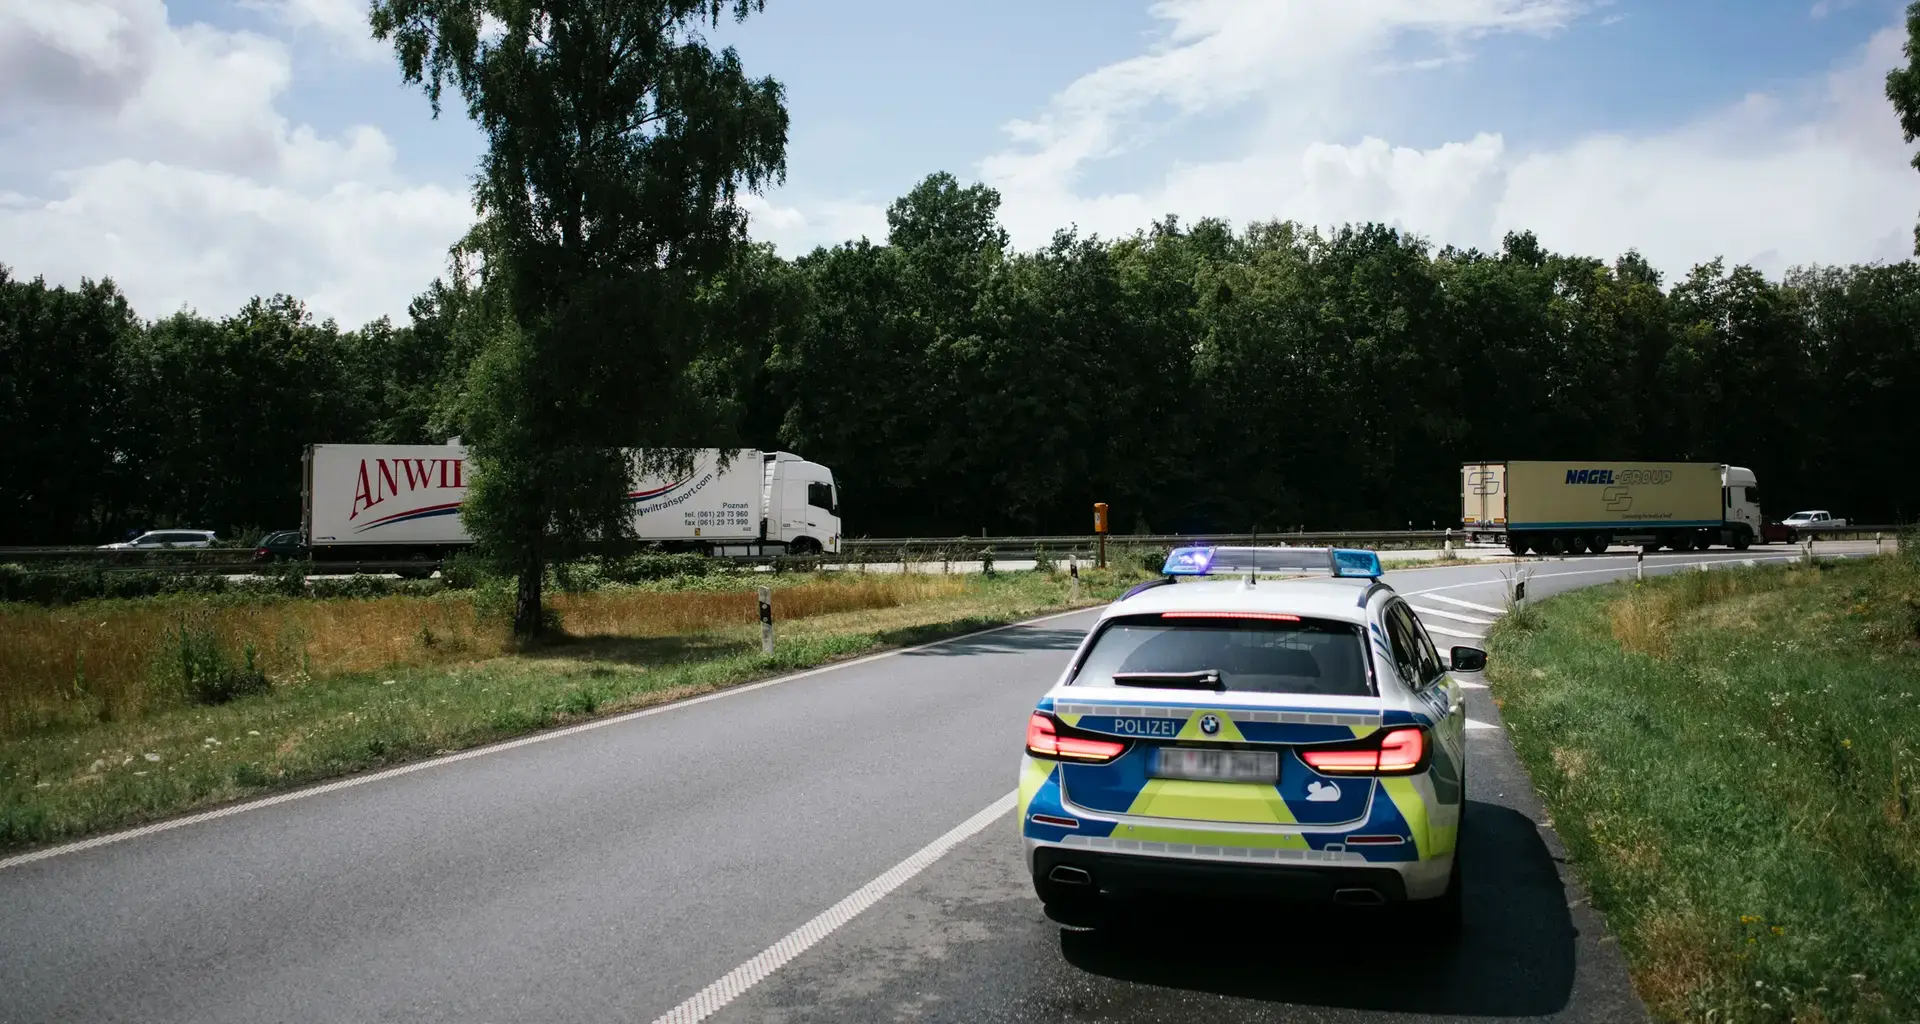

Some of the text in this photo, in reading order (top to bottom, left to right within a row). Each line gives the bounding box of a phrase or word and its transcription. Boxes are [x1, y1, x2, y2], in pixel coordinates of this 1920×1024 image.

[697, 511, 715, 519] (061)
[697, 519, 715, 527] (061)
[1114, 719, 1176, 736] POLIZEI
